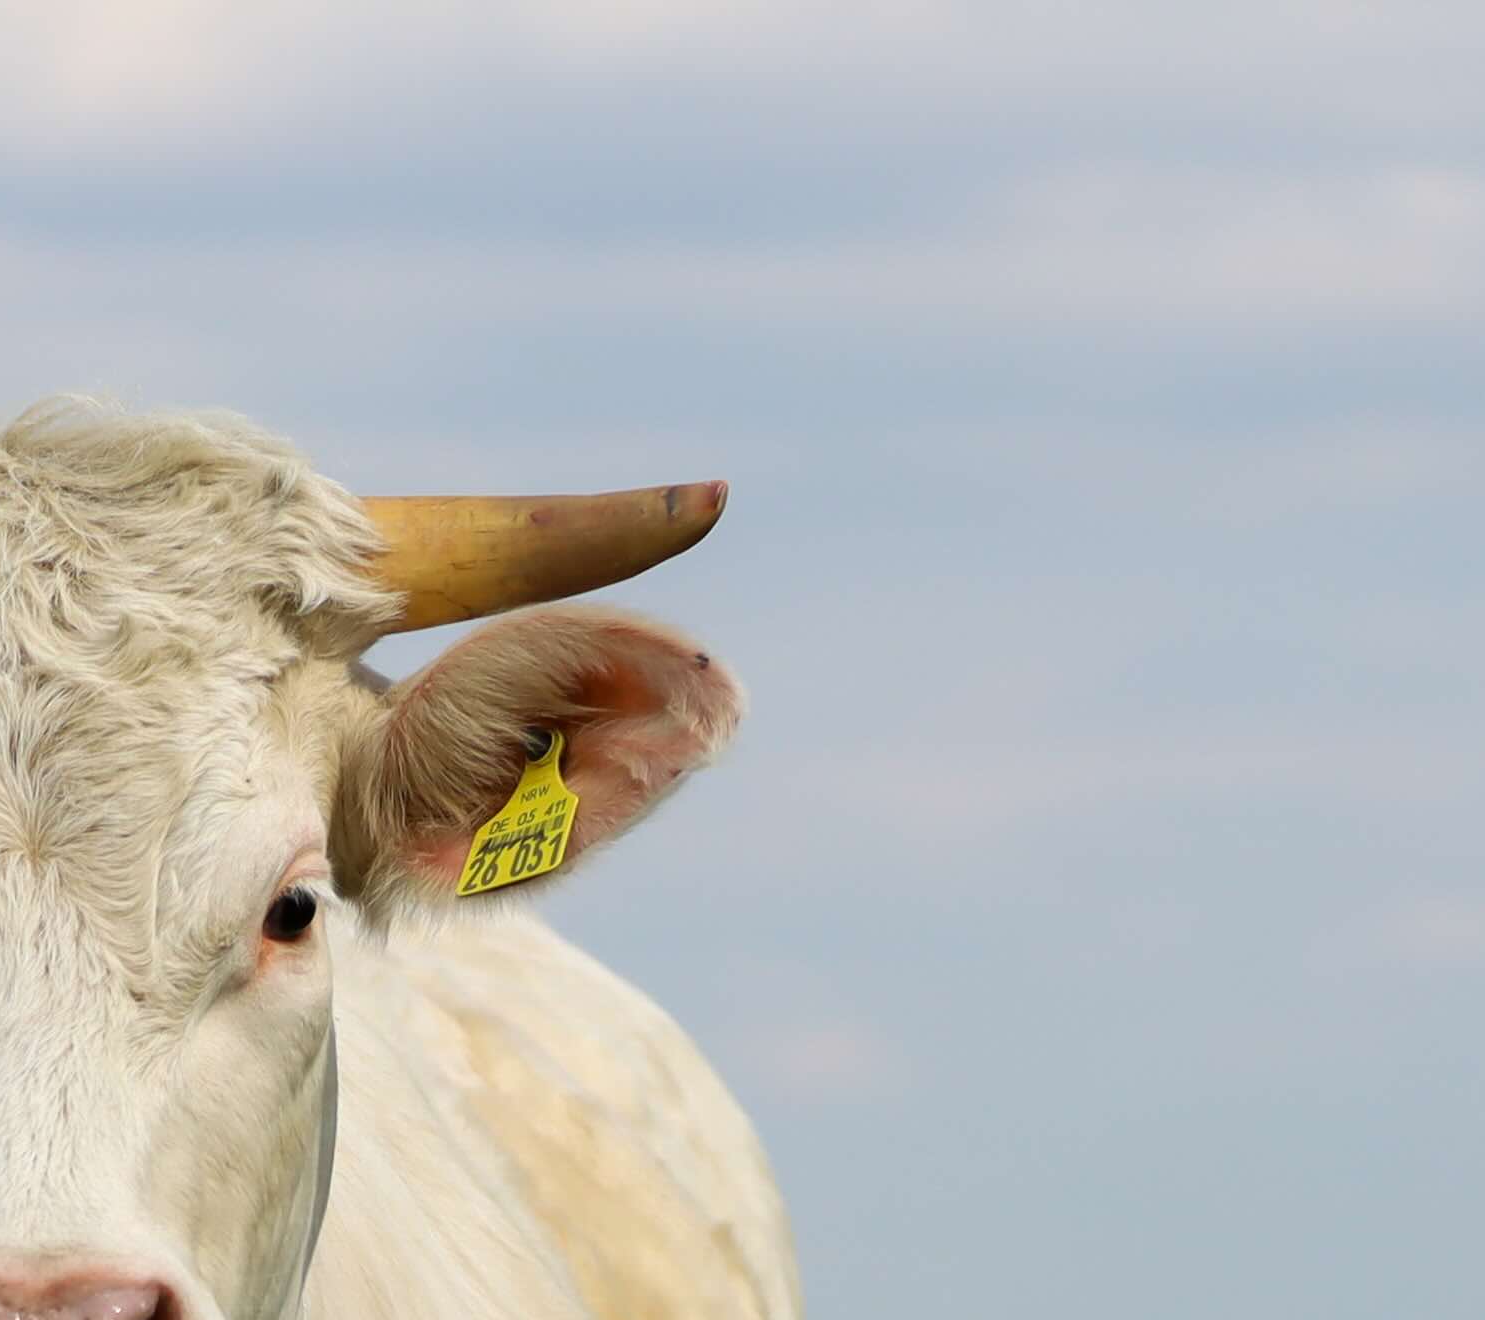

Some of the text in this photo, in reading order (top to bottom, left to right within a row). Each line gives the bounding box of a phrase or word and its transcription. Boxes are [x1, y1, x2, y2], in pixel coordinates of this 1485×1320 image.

[520, 784, 551, 803] NRW
[489, 798, 568, 835] DE 05 411
